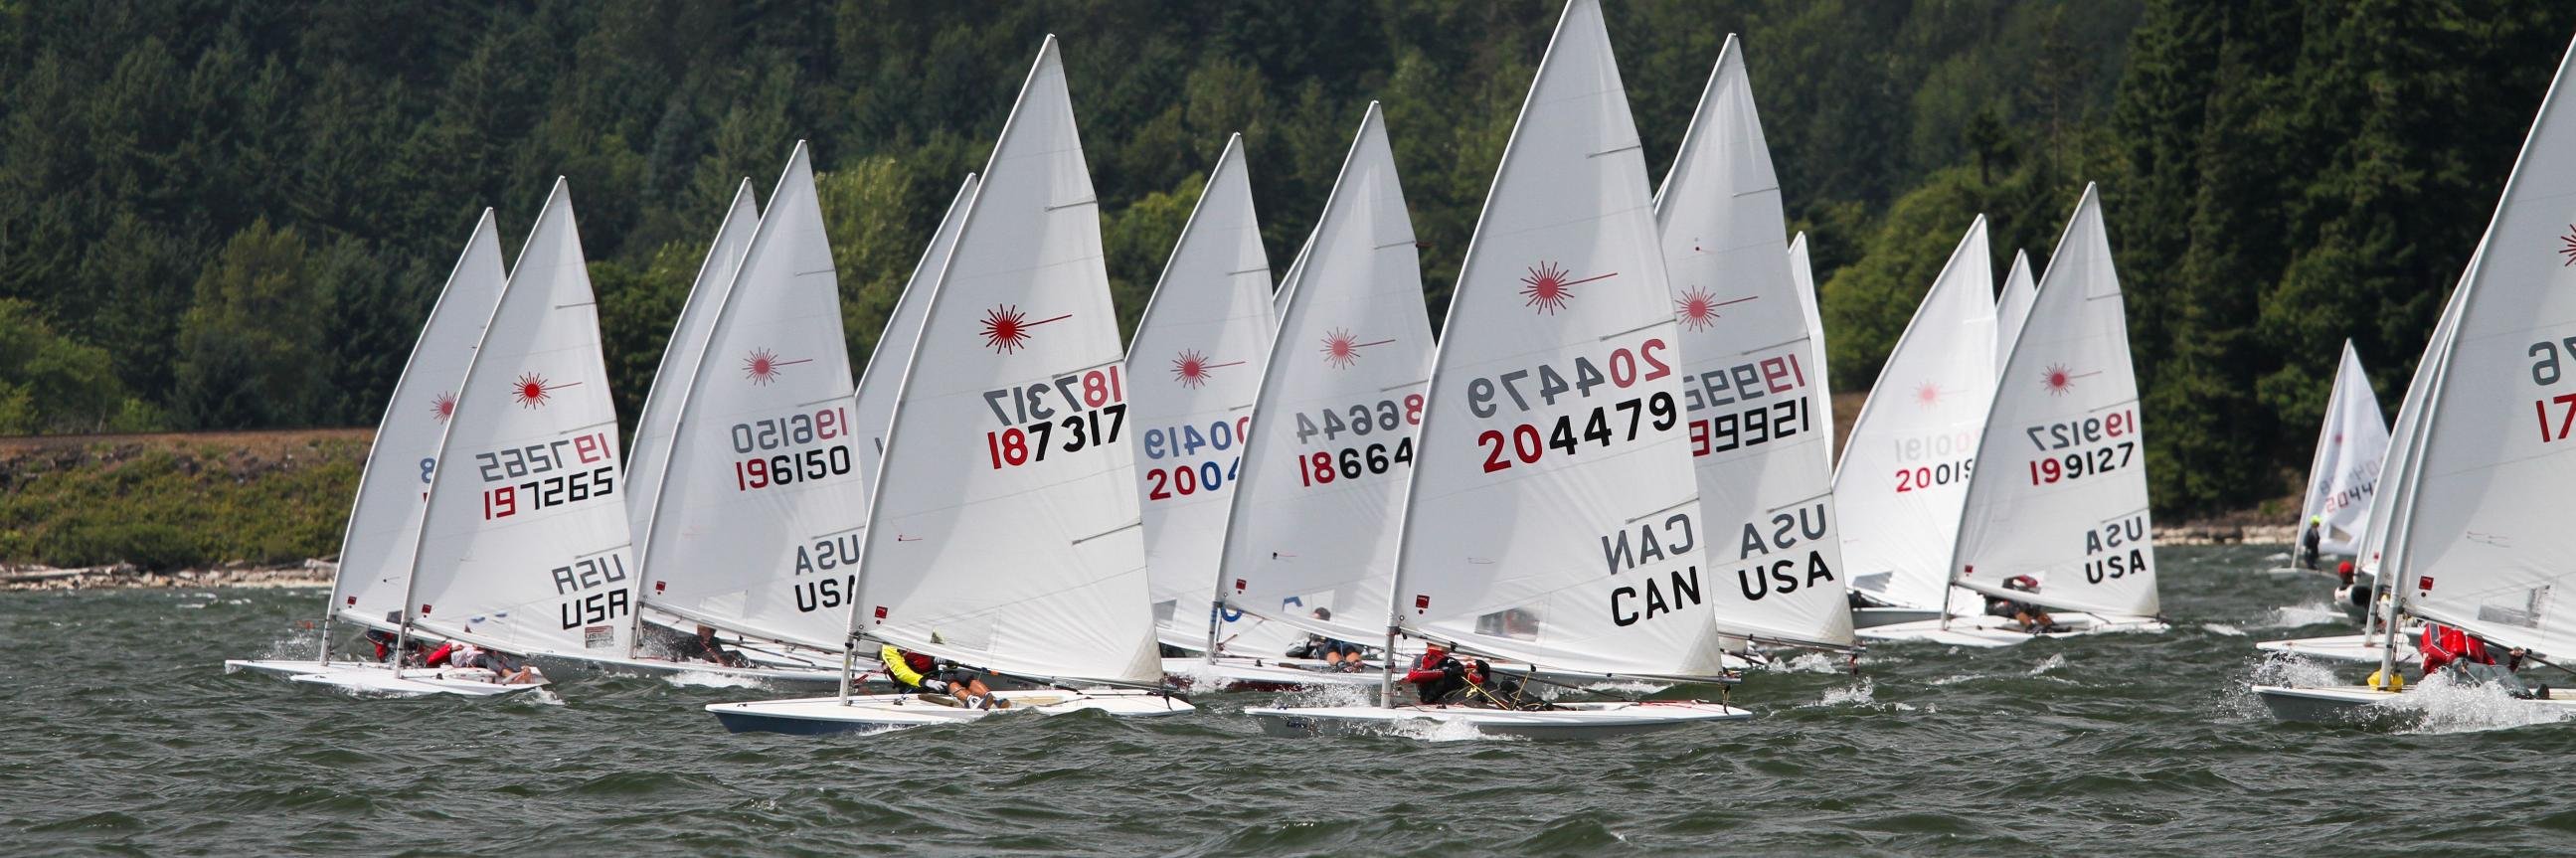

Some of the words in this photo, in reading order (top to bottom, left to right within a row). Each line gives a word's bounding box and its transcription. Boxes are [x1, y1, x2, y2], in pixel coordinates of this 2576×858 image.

[987, 404, 1127, 470] 187317
[1477, 391, 1677, 473] 204479
[2535, 393, 2576, 442] 17
[736, 445, 851, 491] 196150
[2029, 441, 2135, 486] 199127
[484, 466, 613, 520] 197265
[2325, 477, 2378, 513] 2044
[1738, 551, 1834, 601] USA
[2085, 549, 2147, 585] USA
[562, 588, 628, 630] USA
[1611, 565, 1701, 627] CAN
